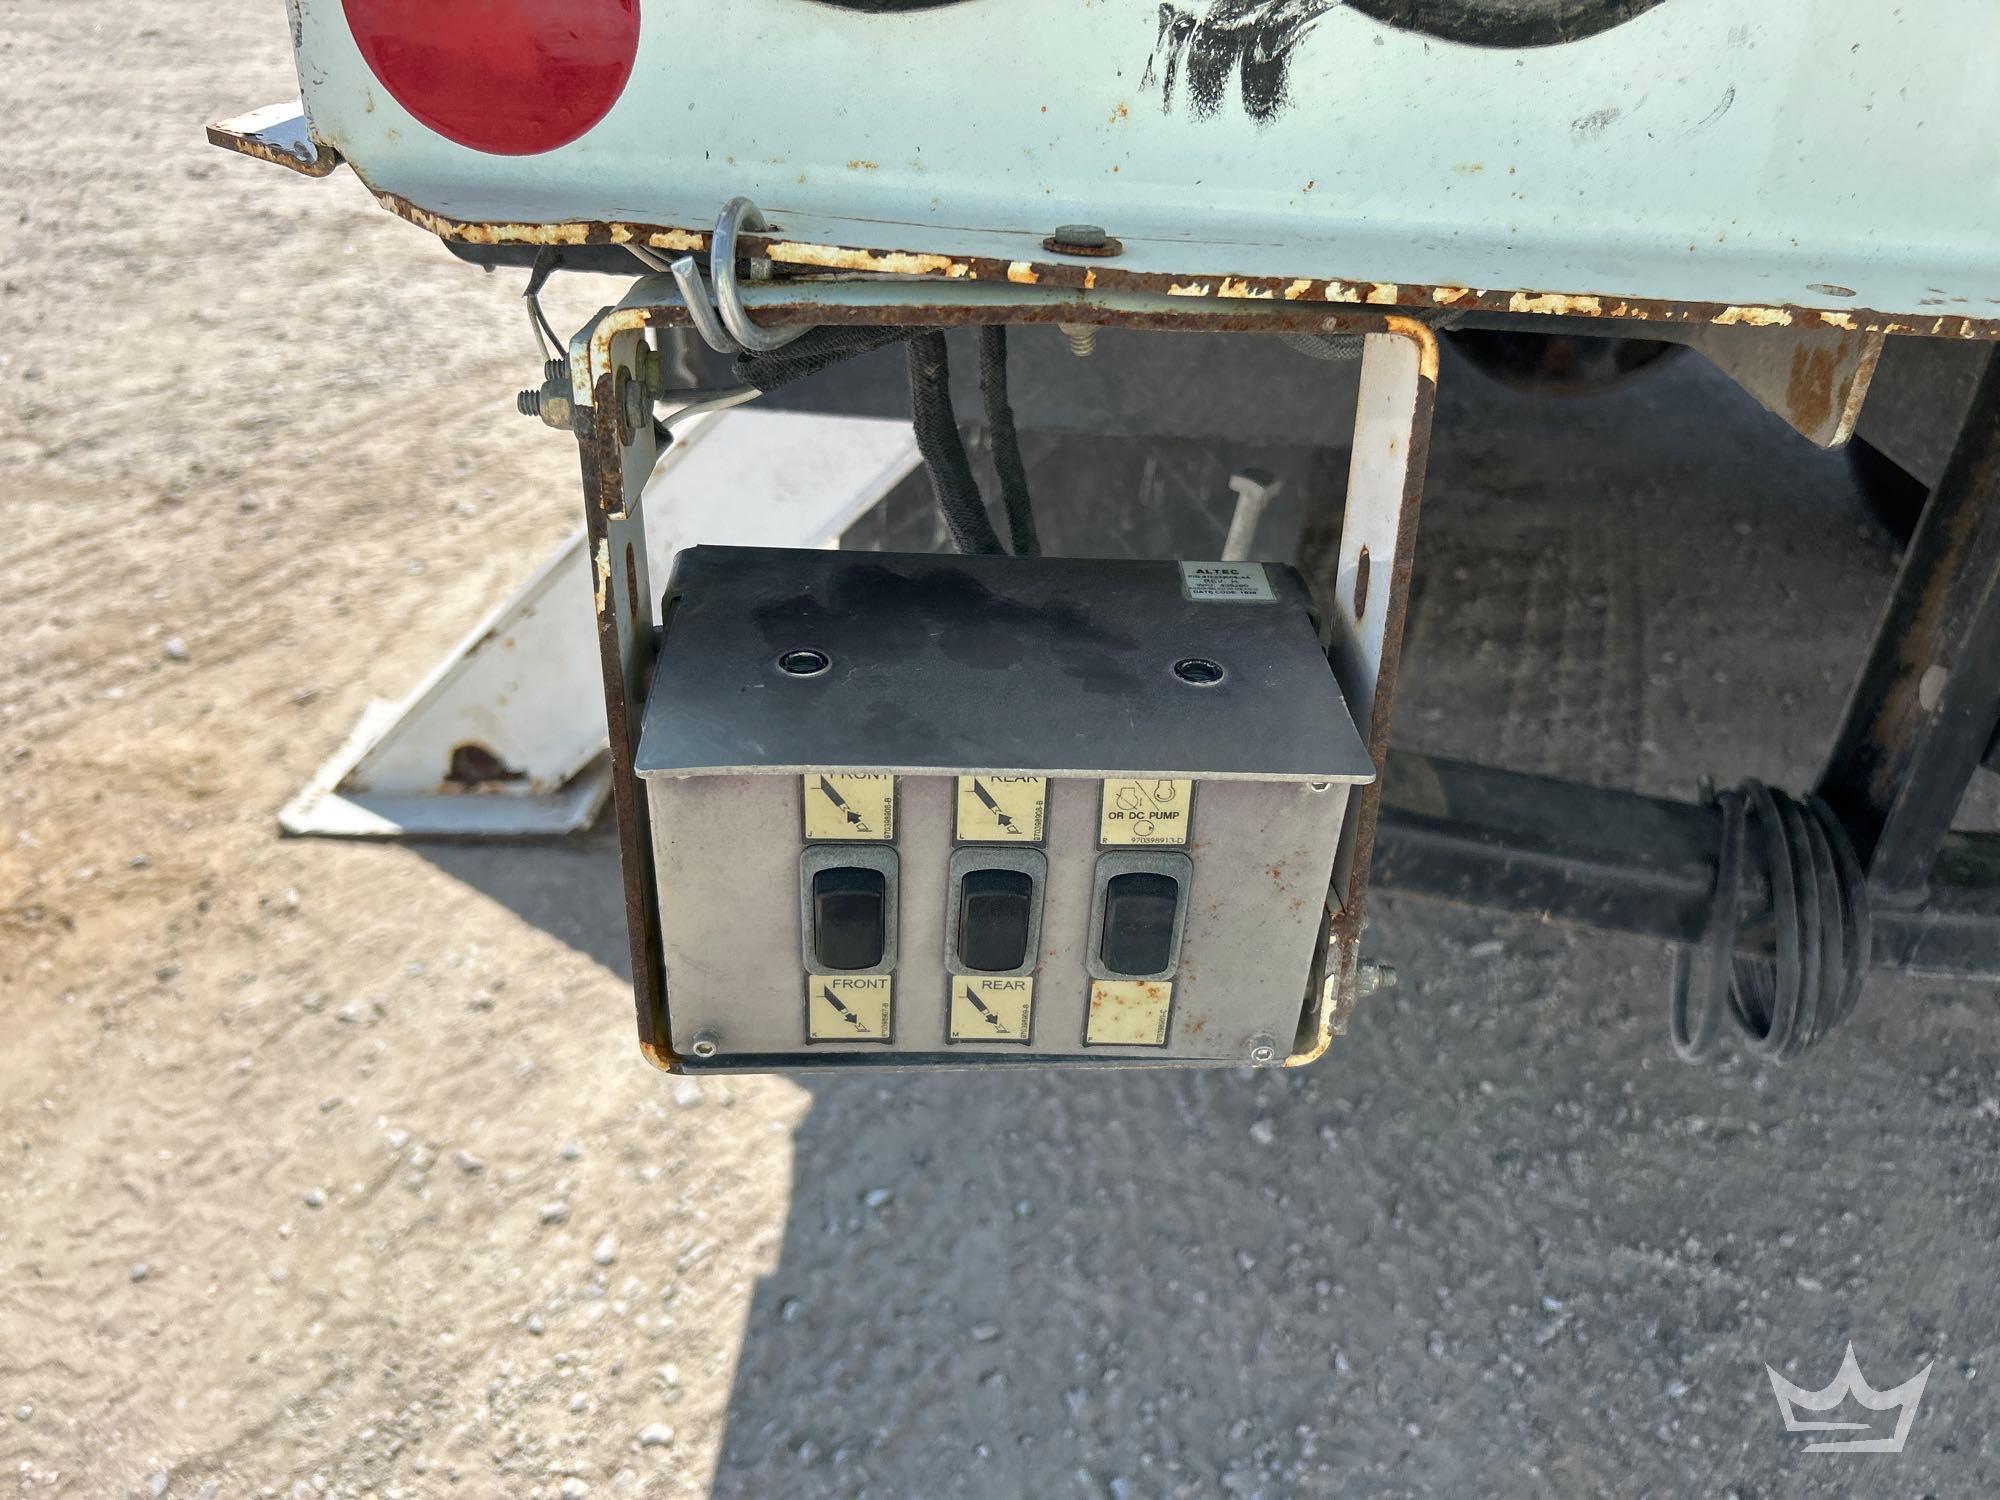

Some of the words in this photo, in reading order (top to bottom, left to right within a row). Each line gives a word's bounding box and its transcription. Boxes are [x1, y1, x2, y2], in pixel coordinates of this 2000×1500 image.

[1108, 811, 1124, 820] OR
[1128, 811, 1145, 820] DC
[1148, 811, 1180, 820] PUMP
[832, 978, 889, 989] FRONT
[981, 980, 1026, 990] REAR
